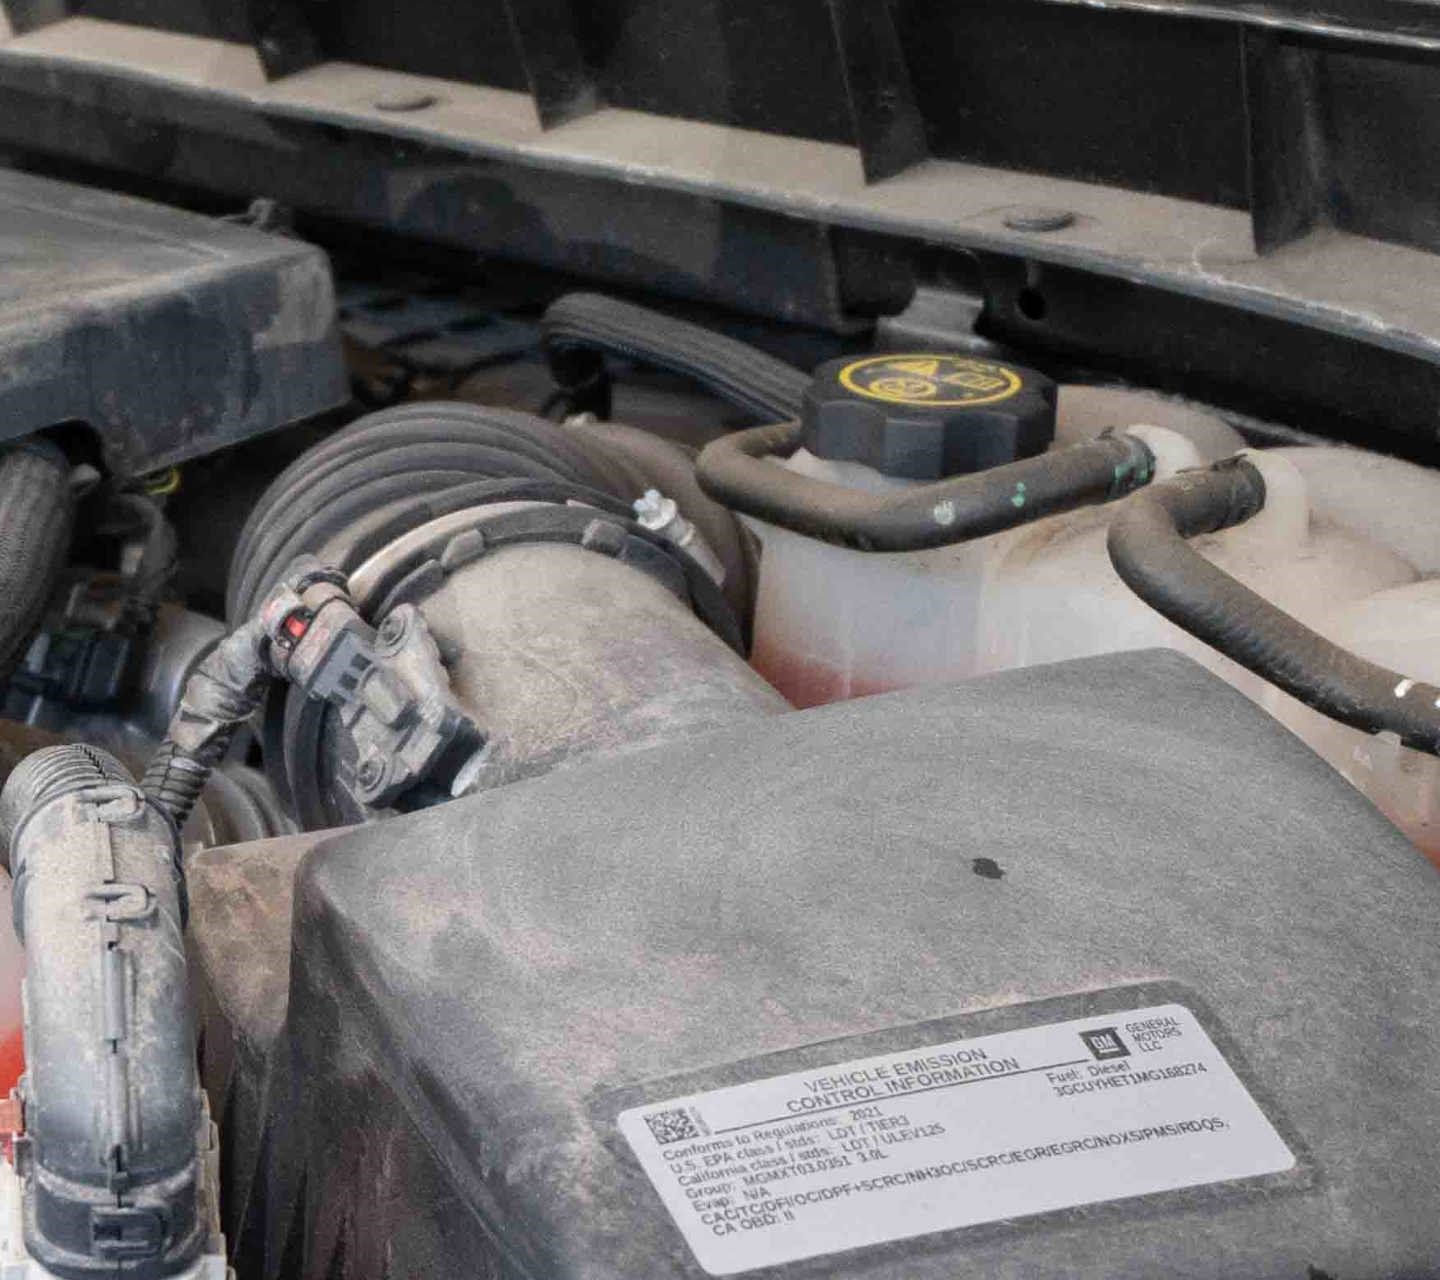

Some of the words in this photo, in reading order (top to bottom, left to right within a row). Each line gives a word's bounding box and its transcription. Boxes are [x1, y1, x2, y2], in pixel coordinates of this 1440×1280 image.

[1124, 1015, 1181, 1034] GENERAL
[1131, 1026, 1183, 1043] MOTORS
[1138, 1040, 1164, 1053] LLC
[803, 1065, 891, 1094] VEHICLE
[893, 1047, 989, 1078] EMISSION
[1087, 1060, 1132, 1077] Diesel
[786, 1082, 884, 1113] CONTROL
[887, 1056, 1022, 1093] INFORMATION
[662, 1138, 734, 1161] Conforms
[736, 1133, 751, 1146] to
[851, 1106, 884, 1122] 2021
[703, 1151, 733, 1166] EPA
[736, 1143, 774, 1160] class
[828, 1125, 857, 1140] LDT
[869, 1114, 911, 1132] TIER3
[677, 1162, 749, 1187] California
[750, 1155, 787, 1172] class
[841, 1137, 870, 1153] LDT
[742, 1186, 772, 1201] N/A
[712, 1222, 737, 1236] CA
